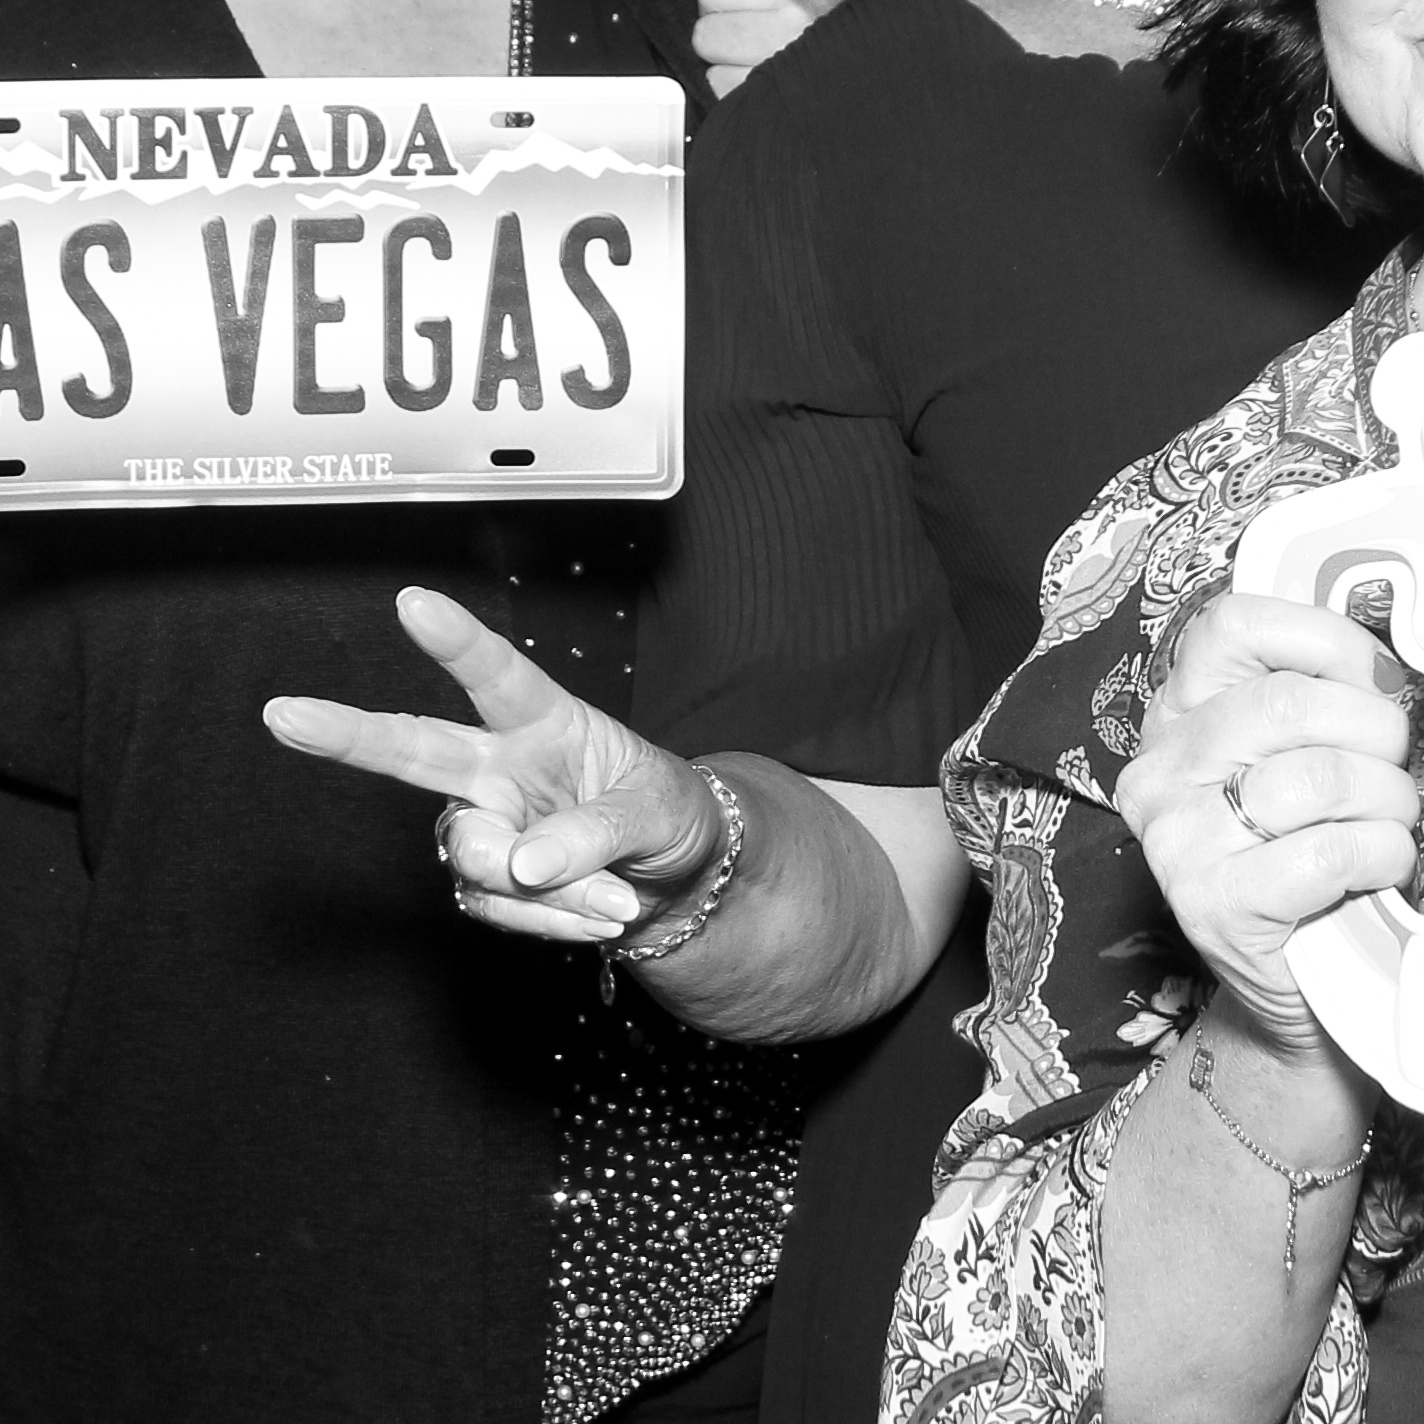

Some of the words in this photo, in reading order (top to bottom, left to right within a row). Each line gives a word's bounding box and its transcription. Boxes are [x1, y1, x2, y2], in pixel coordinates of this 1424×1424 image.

[58, 102, 458, 182] NEVADA
[200, 210, 633, 417] VEGAS
[123, 457, 186, 487] THE
[192, 455, 296, 486] SILVER
[302, 452, 394, 483] STATE
